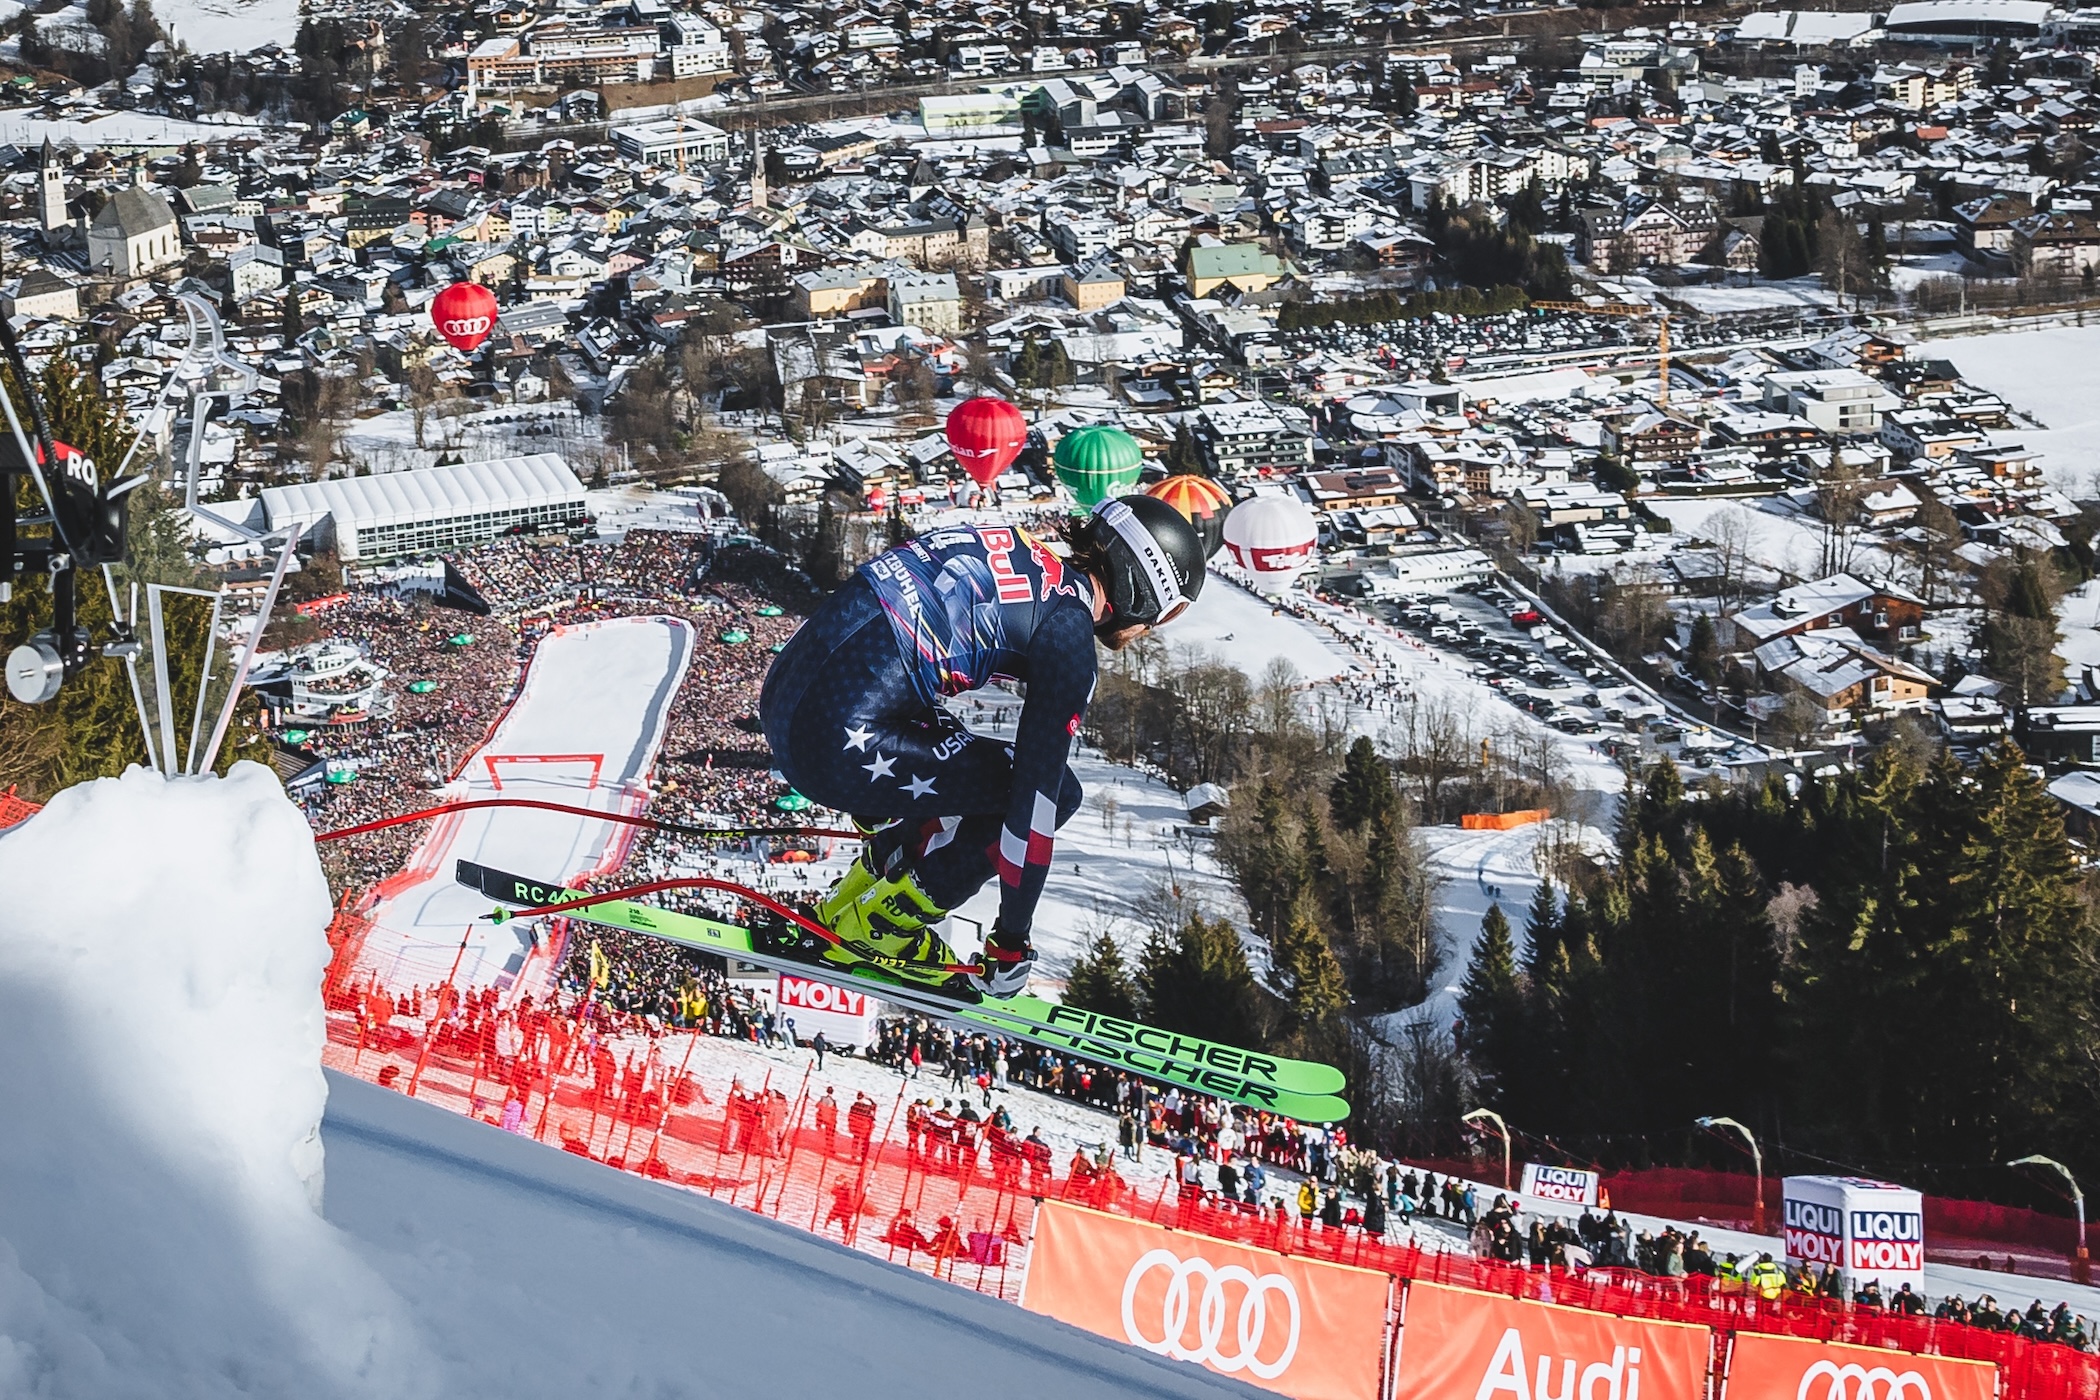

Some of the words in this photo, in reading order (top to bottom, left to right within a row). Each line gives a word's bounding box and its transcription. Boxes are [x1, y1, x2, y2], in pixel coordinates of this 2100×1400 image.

[977, 528, 1034, 604] Bull
[1144, 546, 1175, 601] OAKLEY
[782, 978, 861, 1014] MOLY
[1046, 1005, 1278, 1082] FISCHER
[1534, 1182, 1584, 1202] MOLY
[1537, 1168, 1585, 1187] LIQUI
[1785, 1201, 1840, 1234] LIQUI
[1853, 1213, 1919, 1241] LIQUI
[1786, 1229, 1841, 1263] MOLY
[1854, 1241, 1921, 1269] MOLY
[1475, 1327, 1642, 1400] Audi
